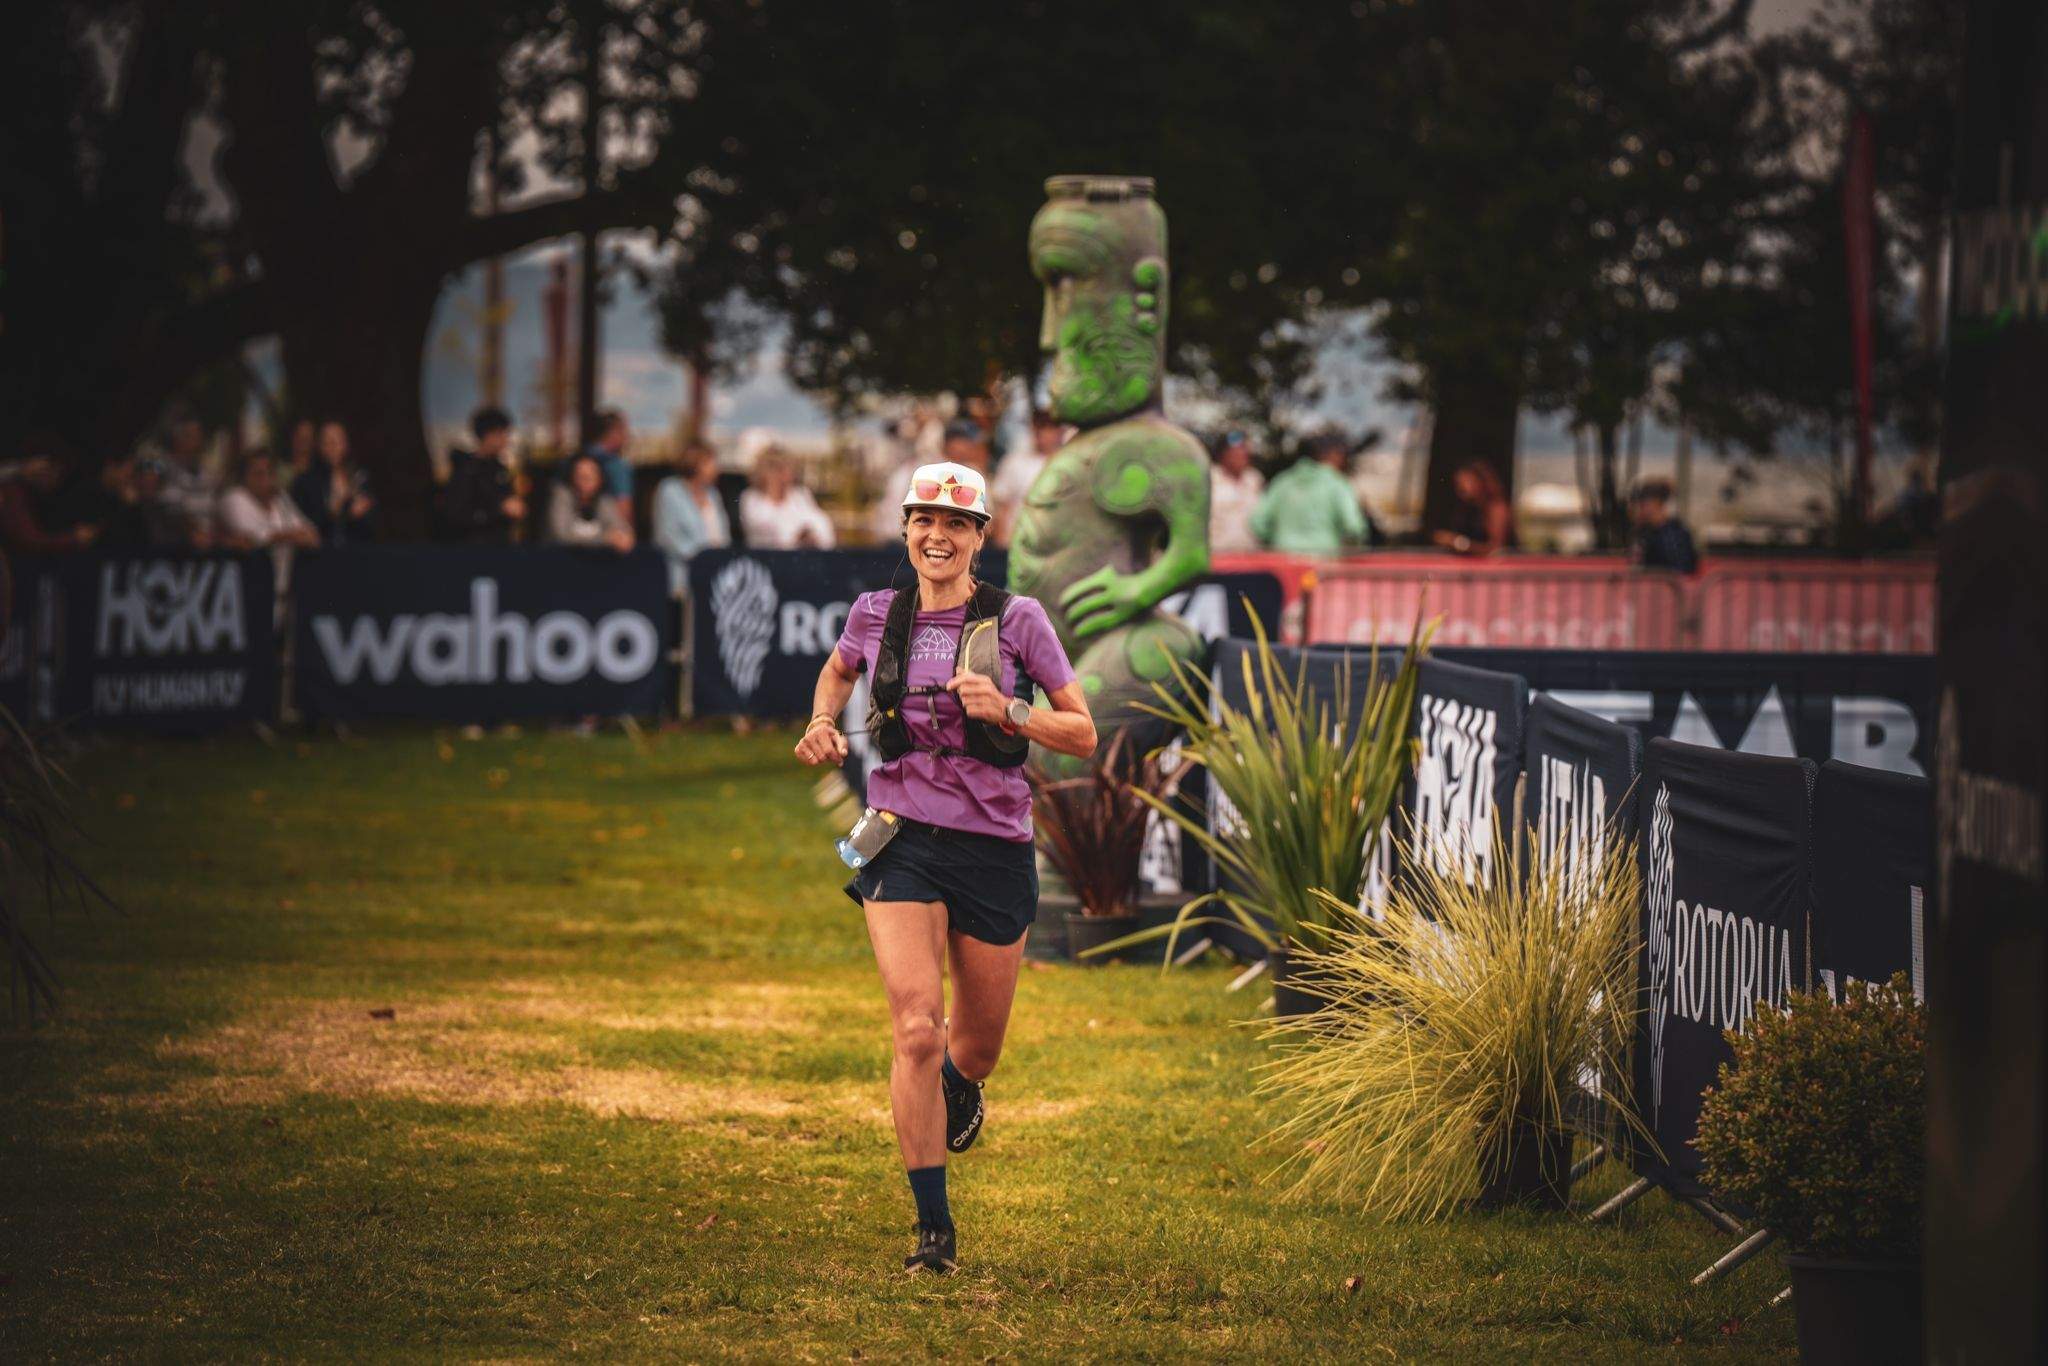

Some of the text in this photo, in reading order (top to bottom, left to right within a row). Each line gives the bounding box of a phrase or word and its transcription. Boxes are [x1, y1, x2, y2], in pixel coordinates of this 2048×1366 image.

[97, 560, 246, 656] HOKA
[311, 576, 659, 686] wahoo
[1673, 899, 1793, 1040] ROTORUA
